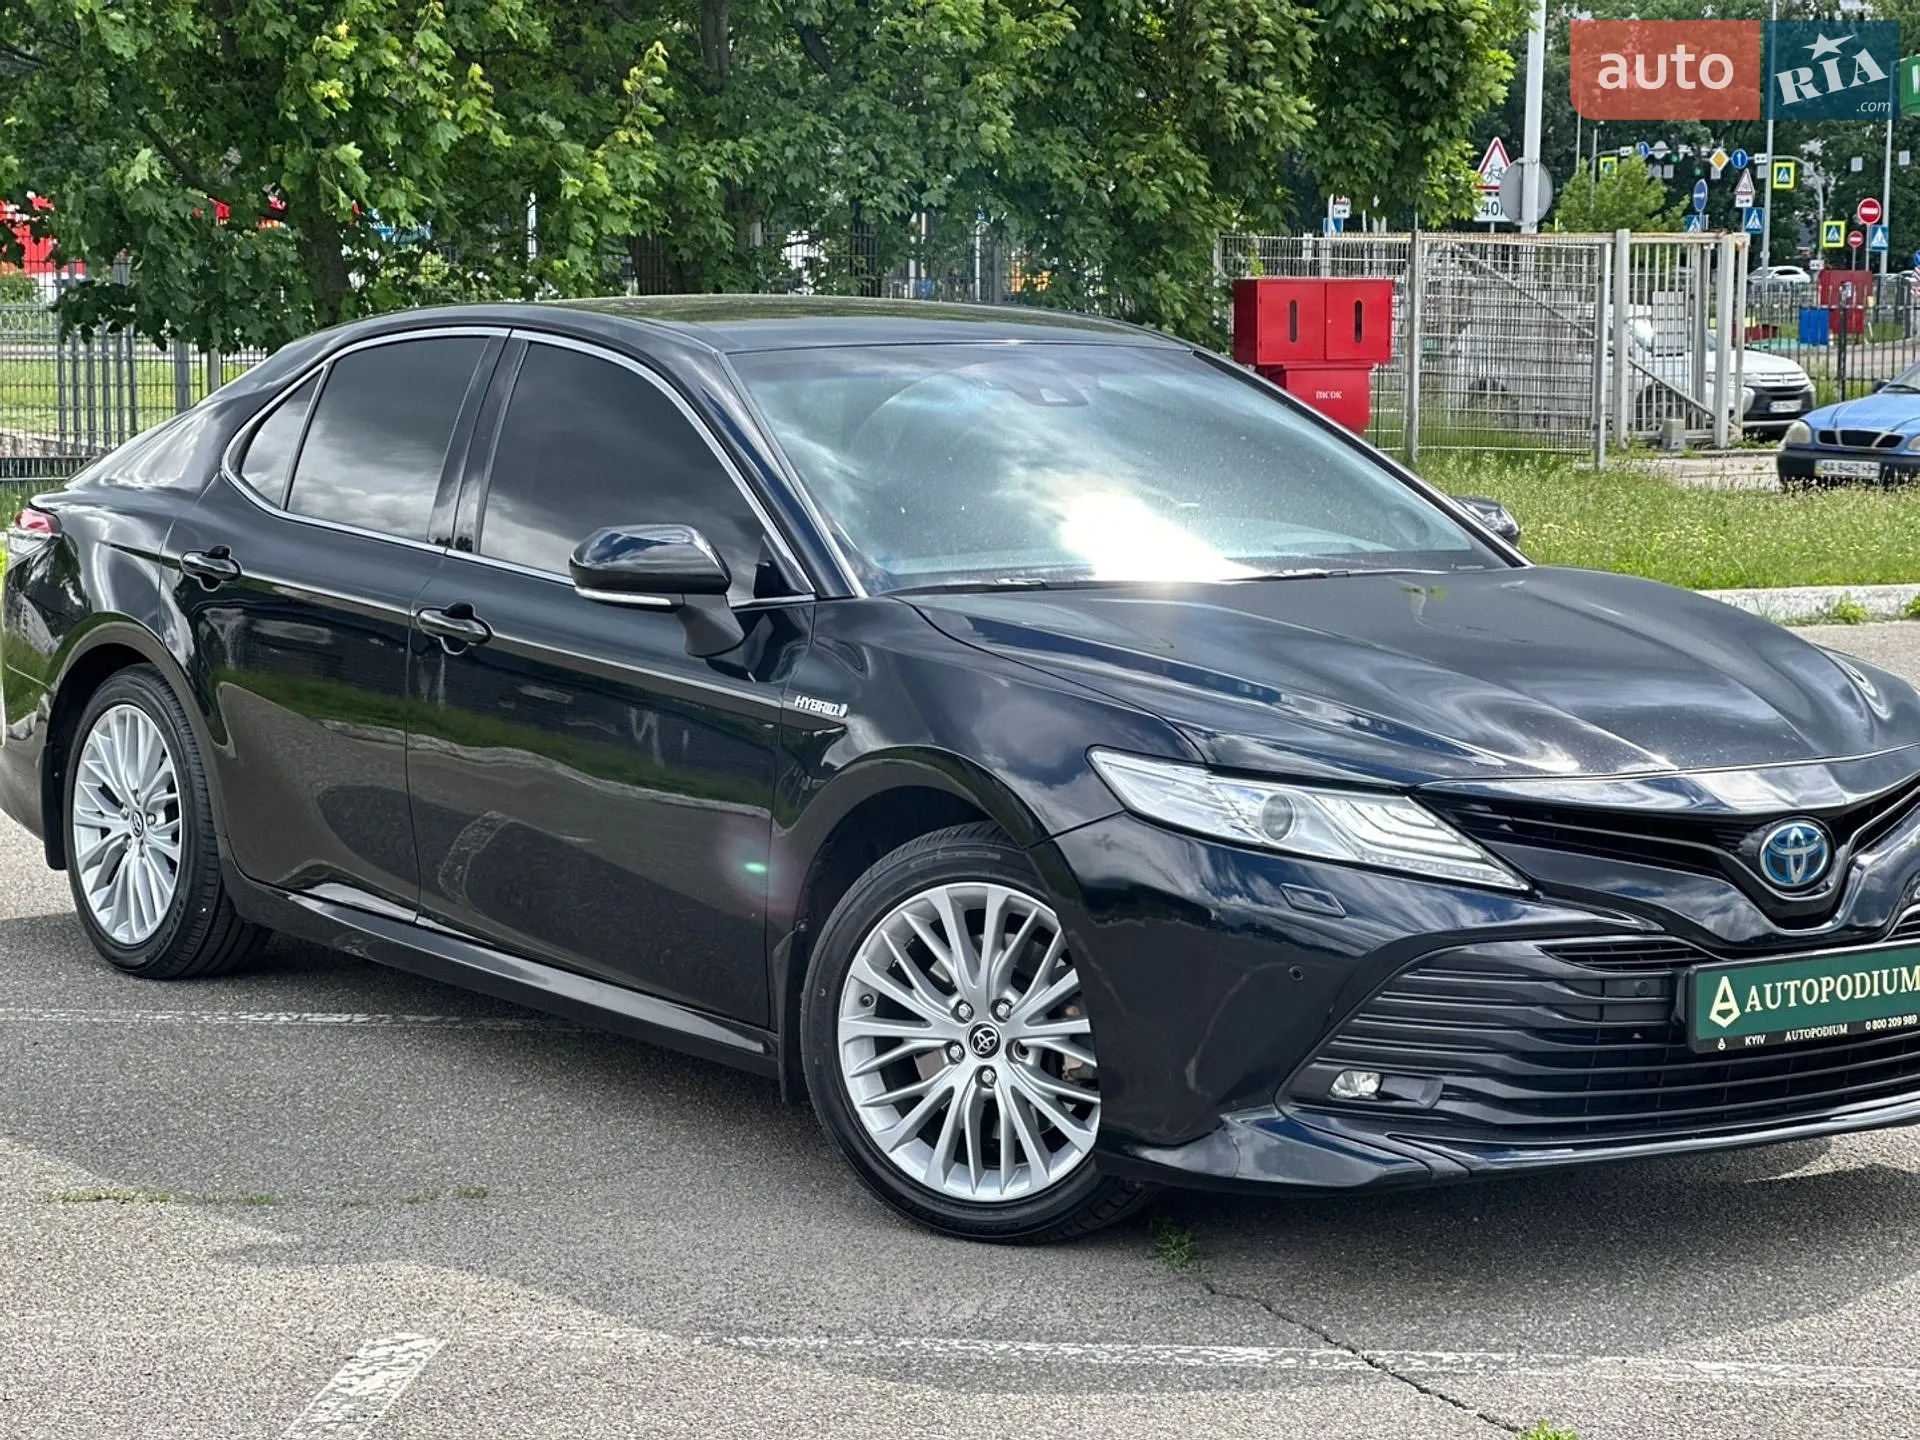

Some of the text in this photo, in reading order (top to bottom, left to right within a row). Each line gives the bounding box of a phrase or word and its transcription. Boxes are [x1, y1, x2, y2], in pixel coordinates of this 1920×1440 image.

[1481, 201, 1503, 216] 40
[794, 695, 839, 715] HYBRID
[1744, 965, 1920, 1013] AUTOPODIUM
[1745, 1034, 1766, 1046] KYIV
[1785, 1023, 1848, 1041] AUTOPODIUM
